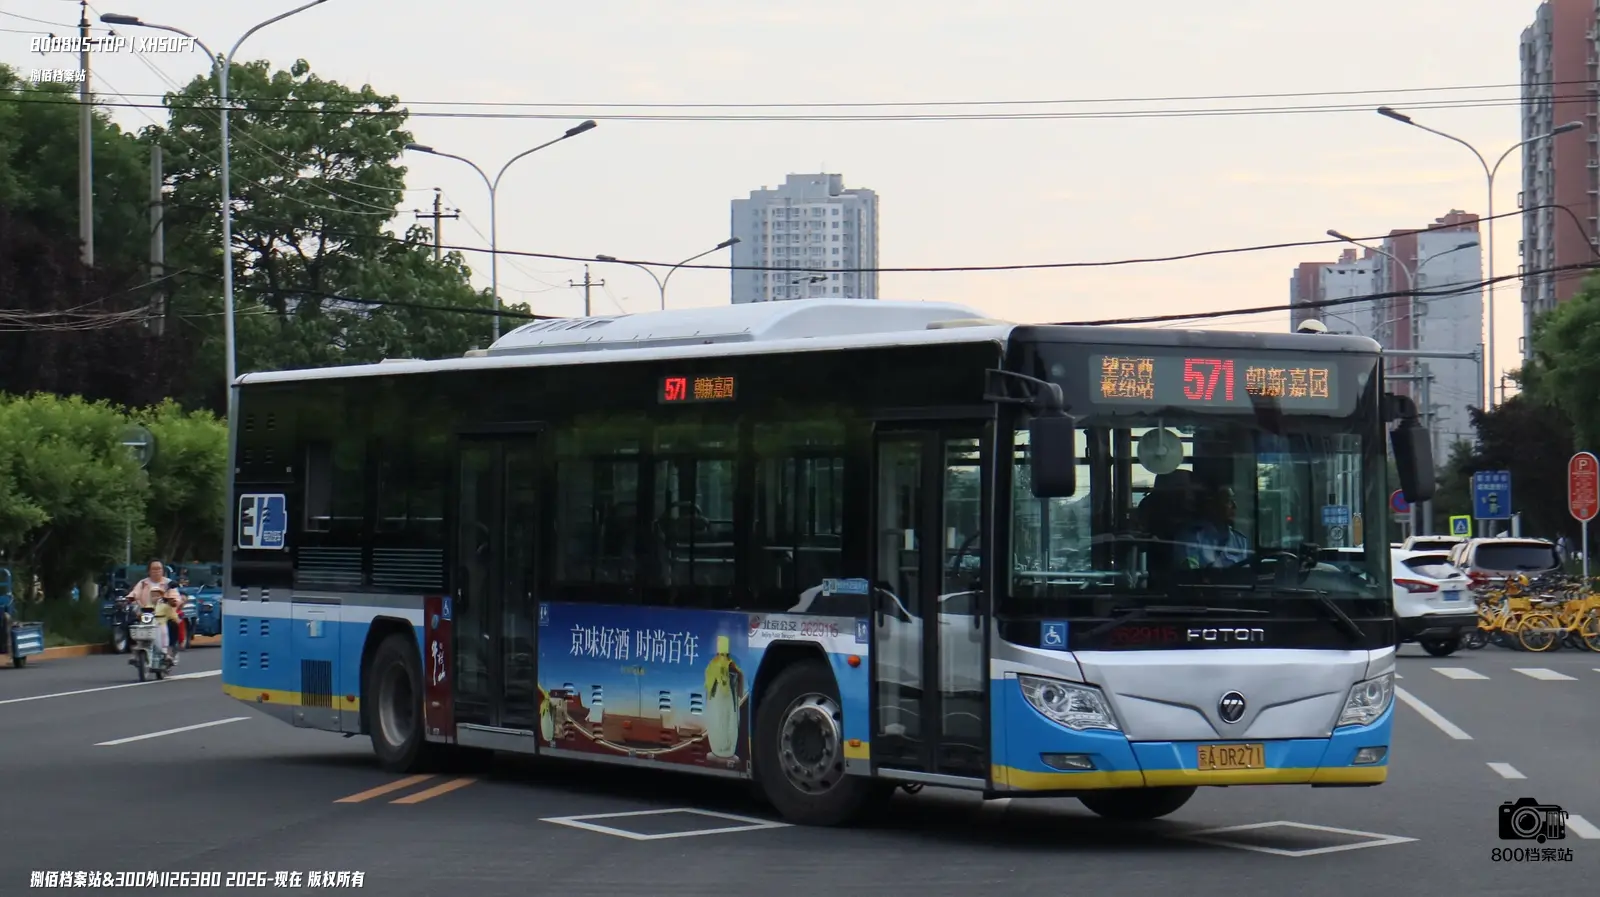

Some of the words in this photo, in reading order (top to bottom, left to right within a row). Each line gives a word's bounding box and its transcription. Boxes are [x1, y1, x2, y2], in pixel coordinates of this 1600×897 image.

[1102, 355, 1155, 378] 望京西
[665, 378, 687, 400] 571
[1183, 358, 1235, 401] 571
[1245, 366, 1329, 398] 朝新嘉园
[1578, 459, 1588, 470] P
[762, 619, 797, 631] 北京公交
[800, 621, 839, 638] 2629115
[1187, 628, 1265, 642] FOTON
[569, 623, 630, 661] 京味好酒
[636, 629, 699, 666] 时尚百年
